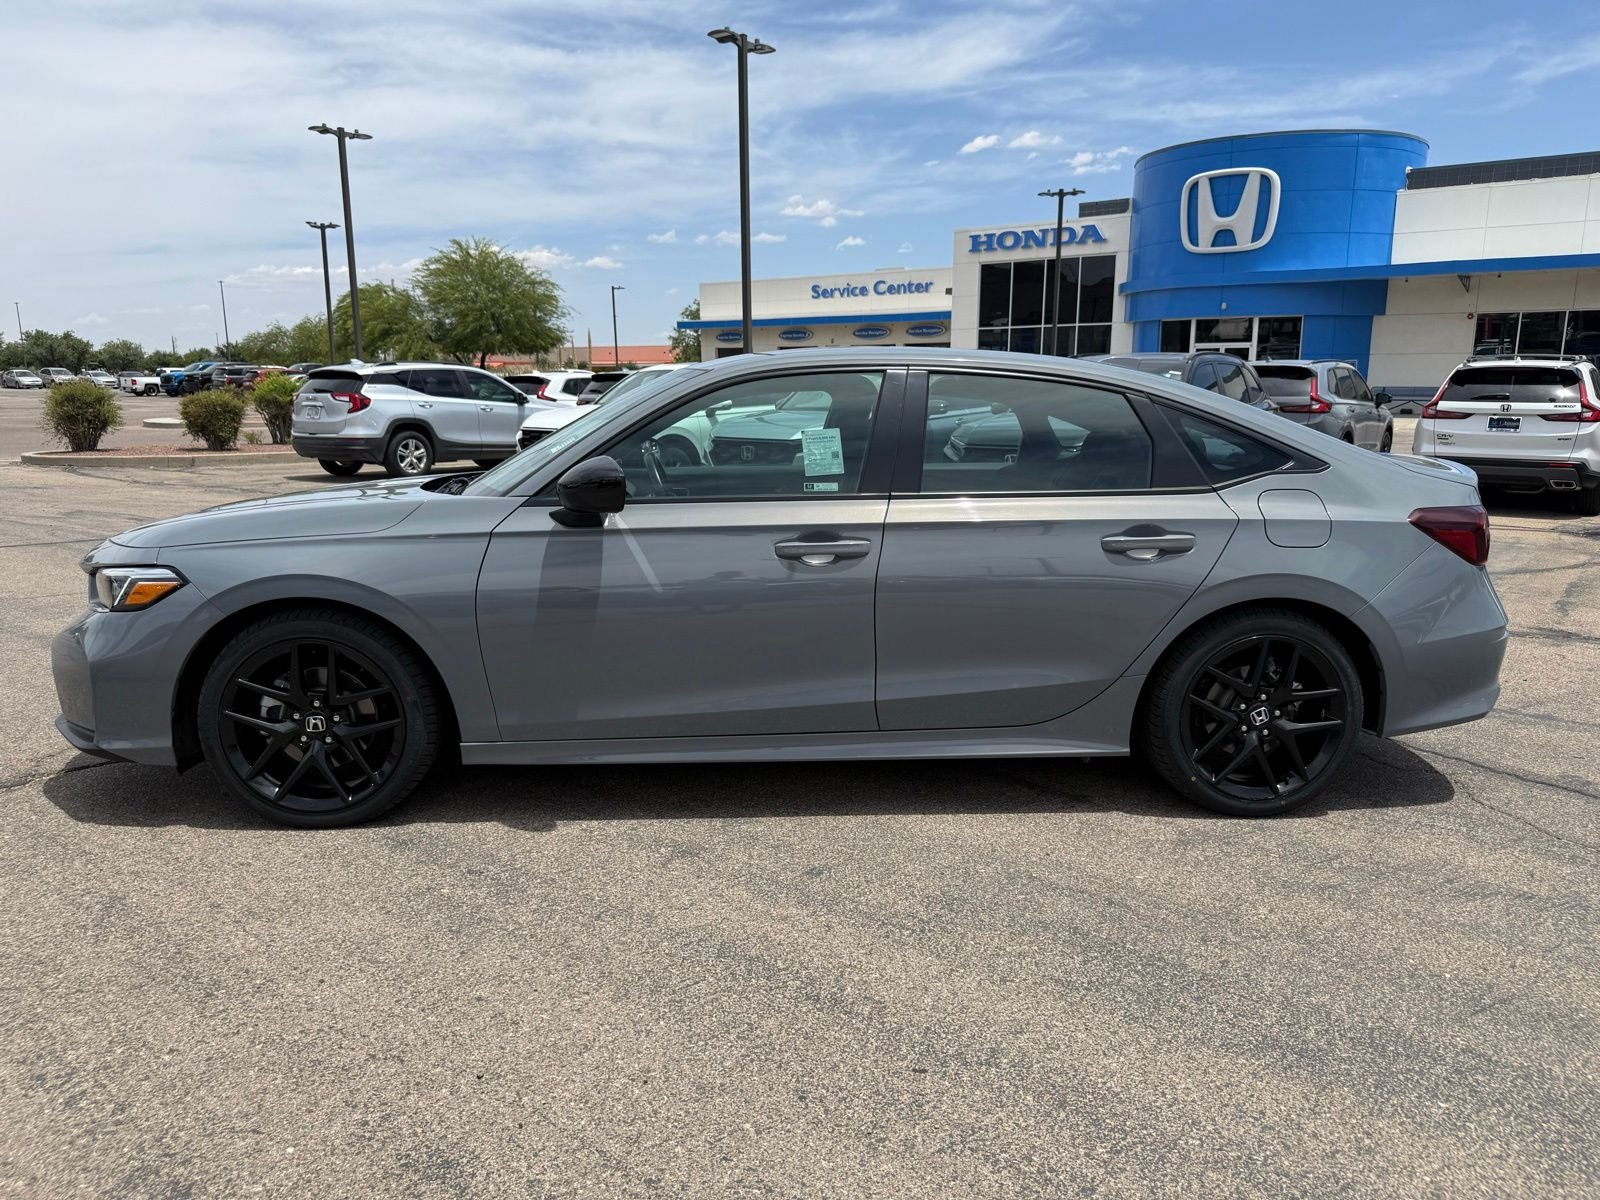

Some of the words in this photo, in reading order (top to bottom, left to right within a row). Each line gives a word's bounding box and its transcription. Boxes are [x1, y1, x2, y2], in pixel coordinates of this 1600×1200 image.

[968, 224, 1107, 253] HONDA
[811, 282, 869, 299] Service
[873, 280, 934, 296] Center
